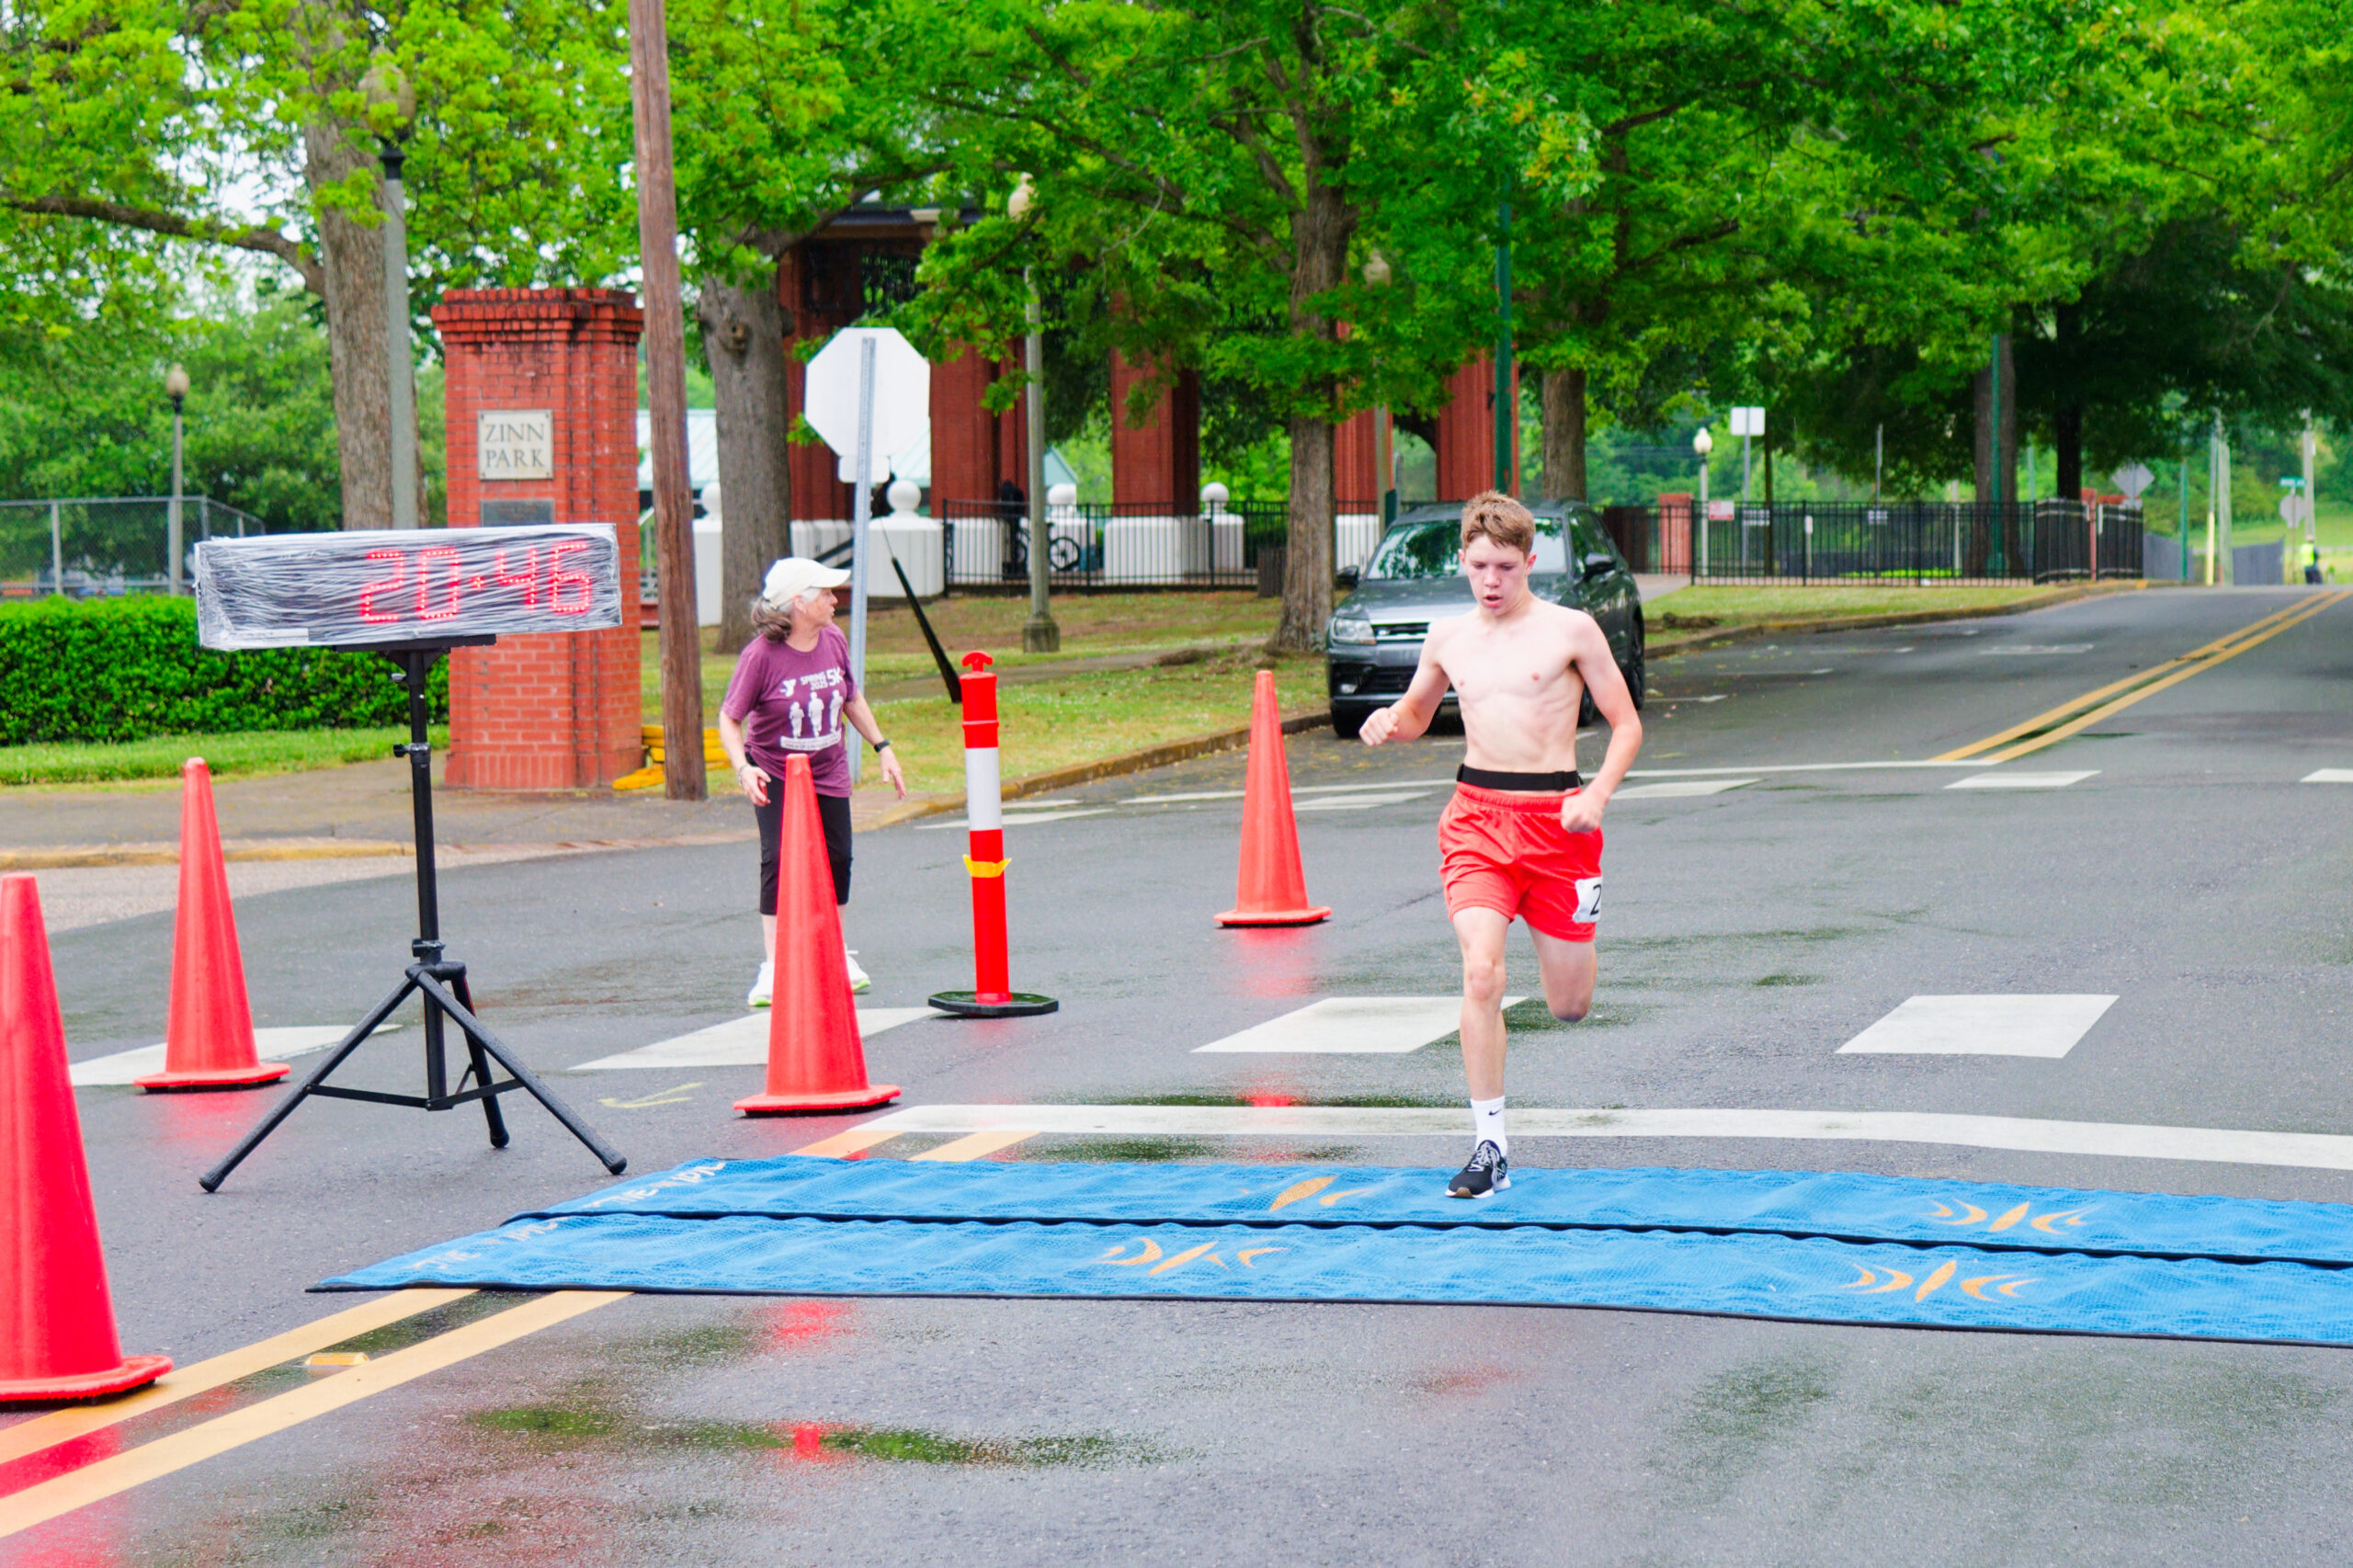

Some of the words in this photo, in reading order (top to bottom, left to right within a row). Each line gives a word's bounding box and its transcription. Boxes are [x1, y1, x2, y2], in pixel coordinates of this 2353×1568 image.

[484, 423, 545, 442] ZINN
[485, 449, 545, 468] PARK
[826, 666, 843, 686] 5K
